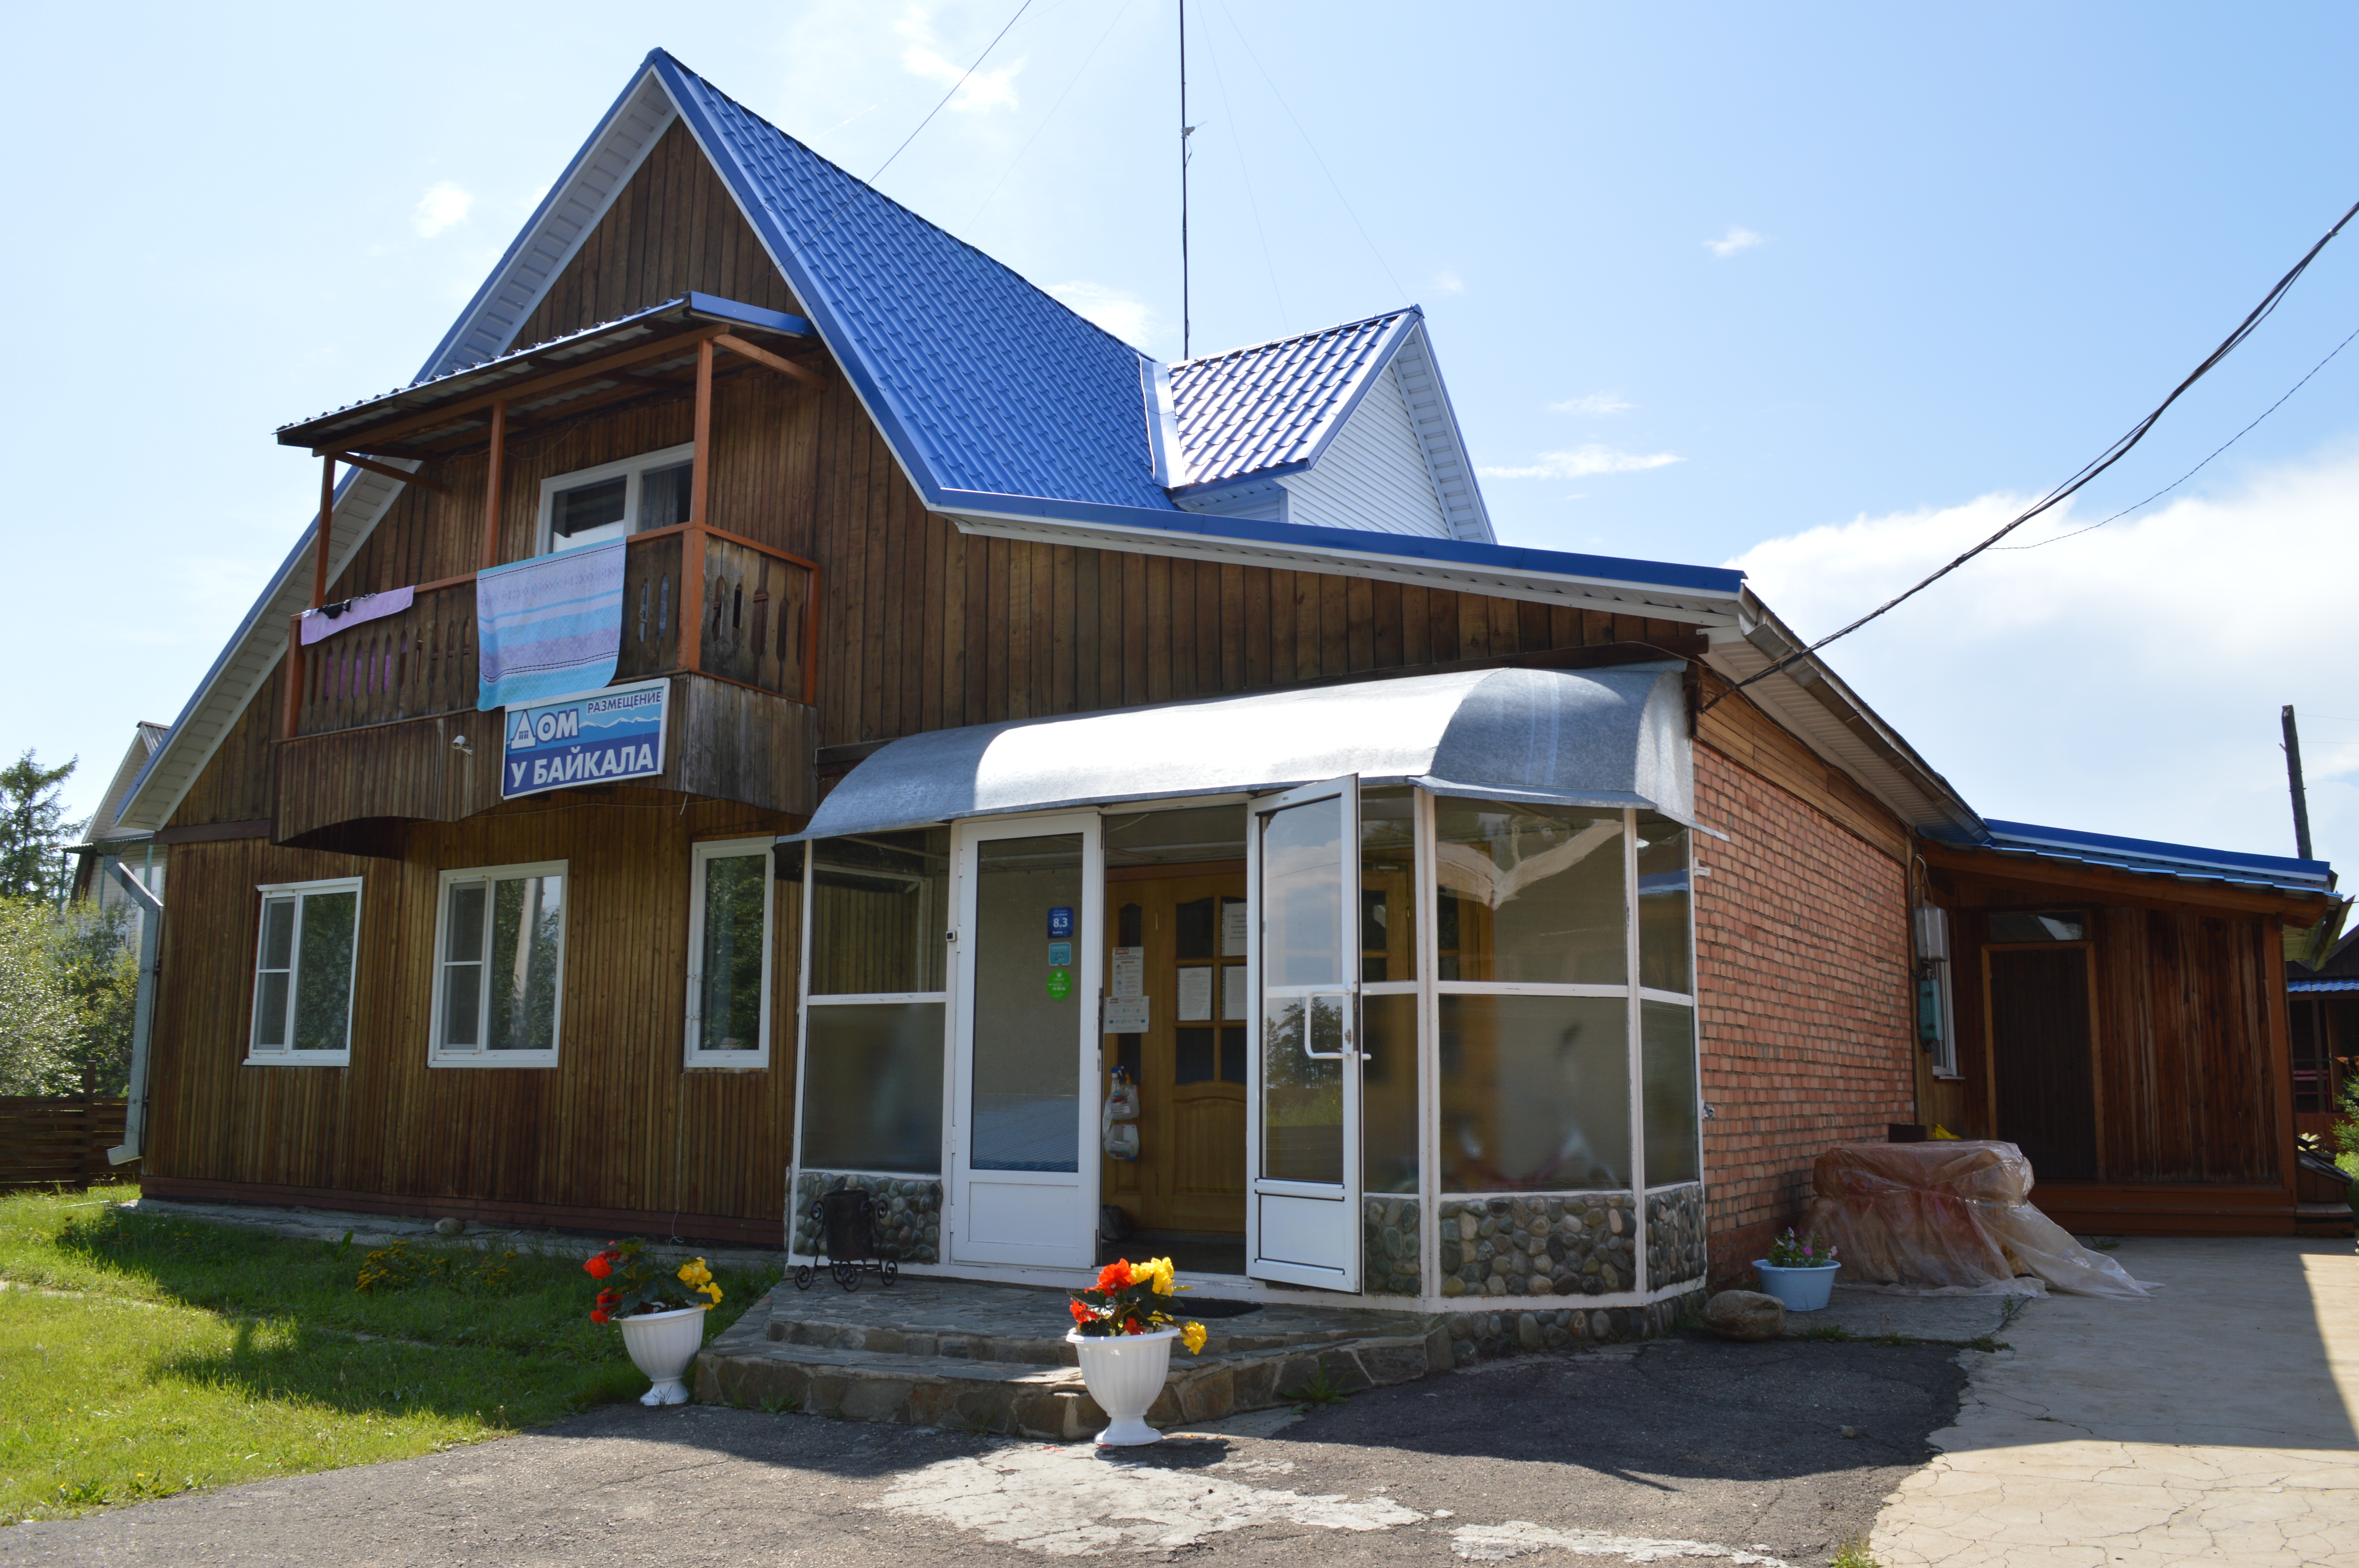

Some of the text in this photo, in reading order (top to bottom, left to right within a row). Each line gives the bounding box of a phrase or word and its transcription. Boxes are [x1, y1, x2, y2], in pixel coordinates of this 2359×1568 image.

[588, 691, 661, 714] РАЗМЕЩЕНИЕ
[511, 708, 579, 751] ДОМ
[511, 744, 654, 788] У БАЙКАЛА
[1053, 918, 1068, 928] 8,3
